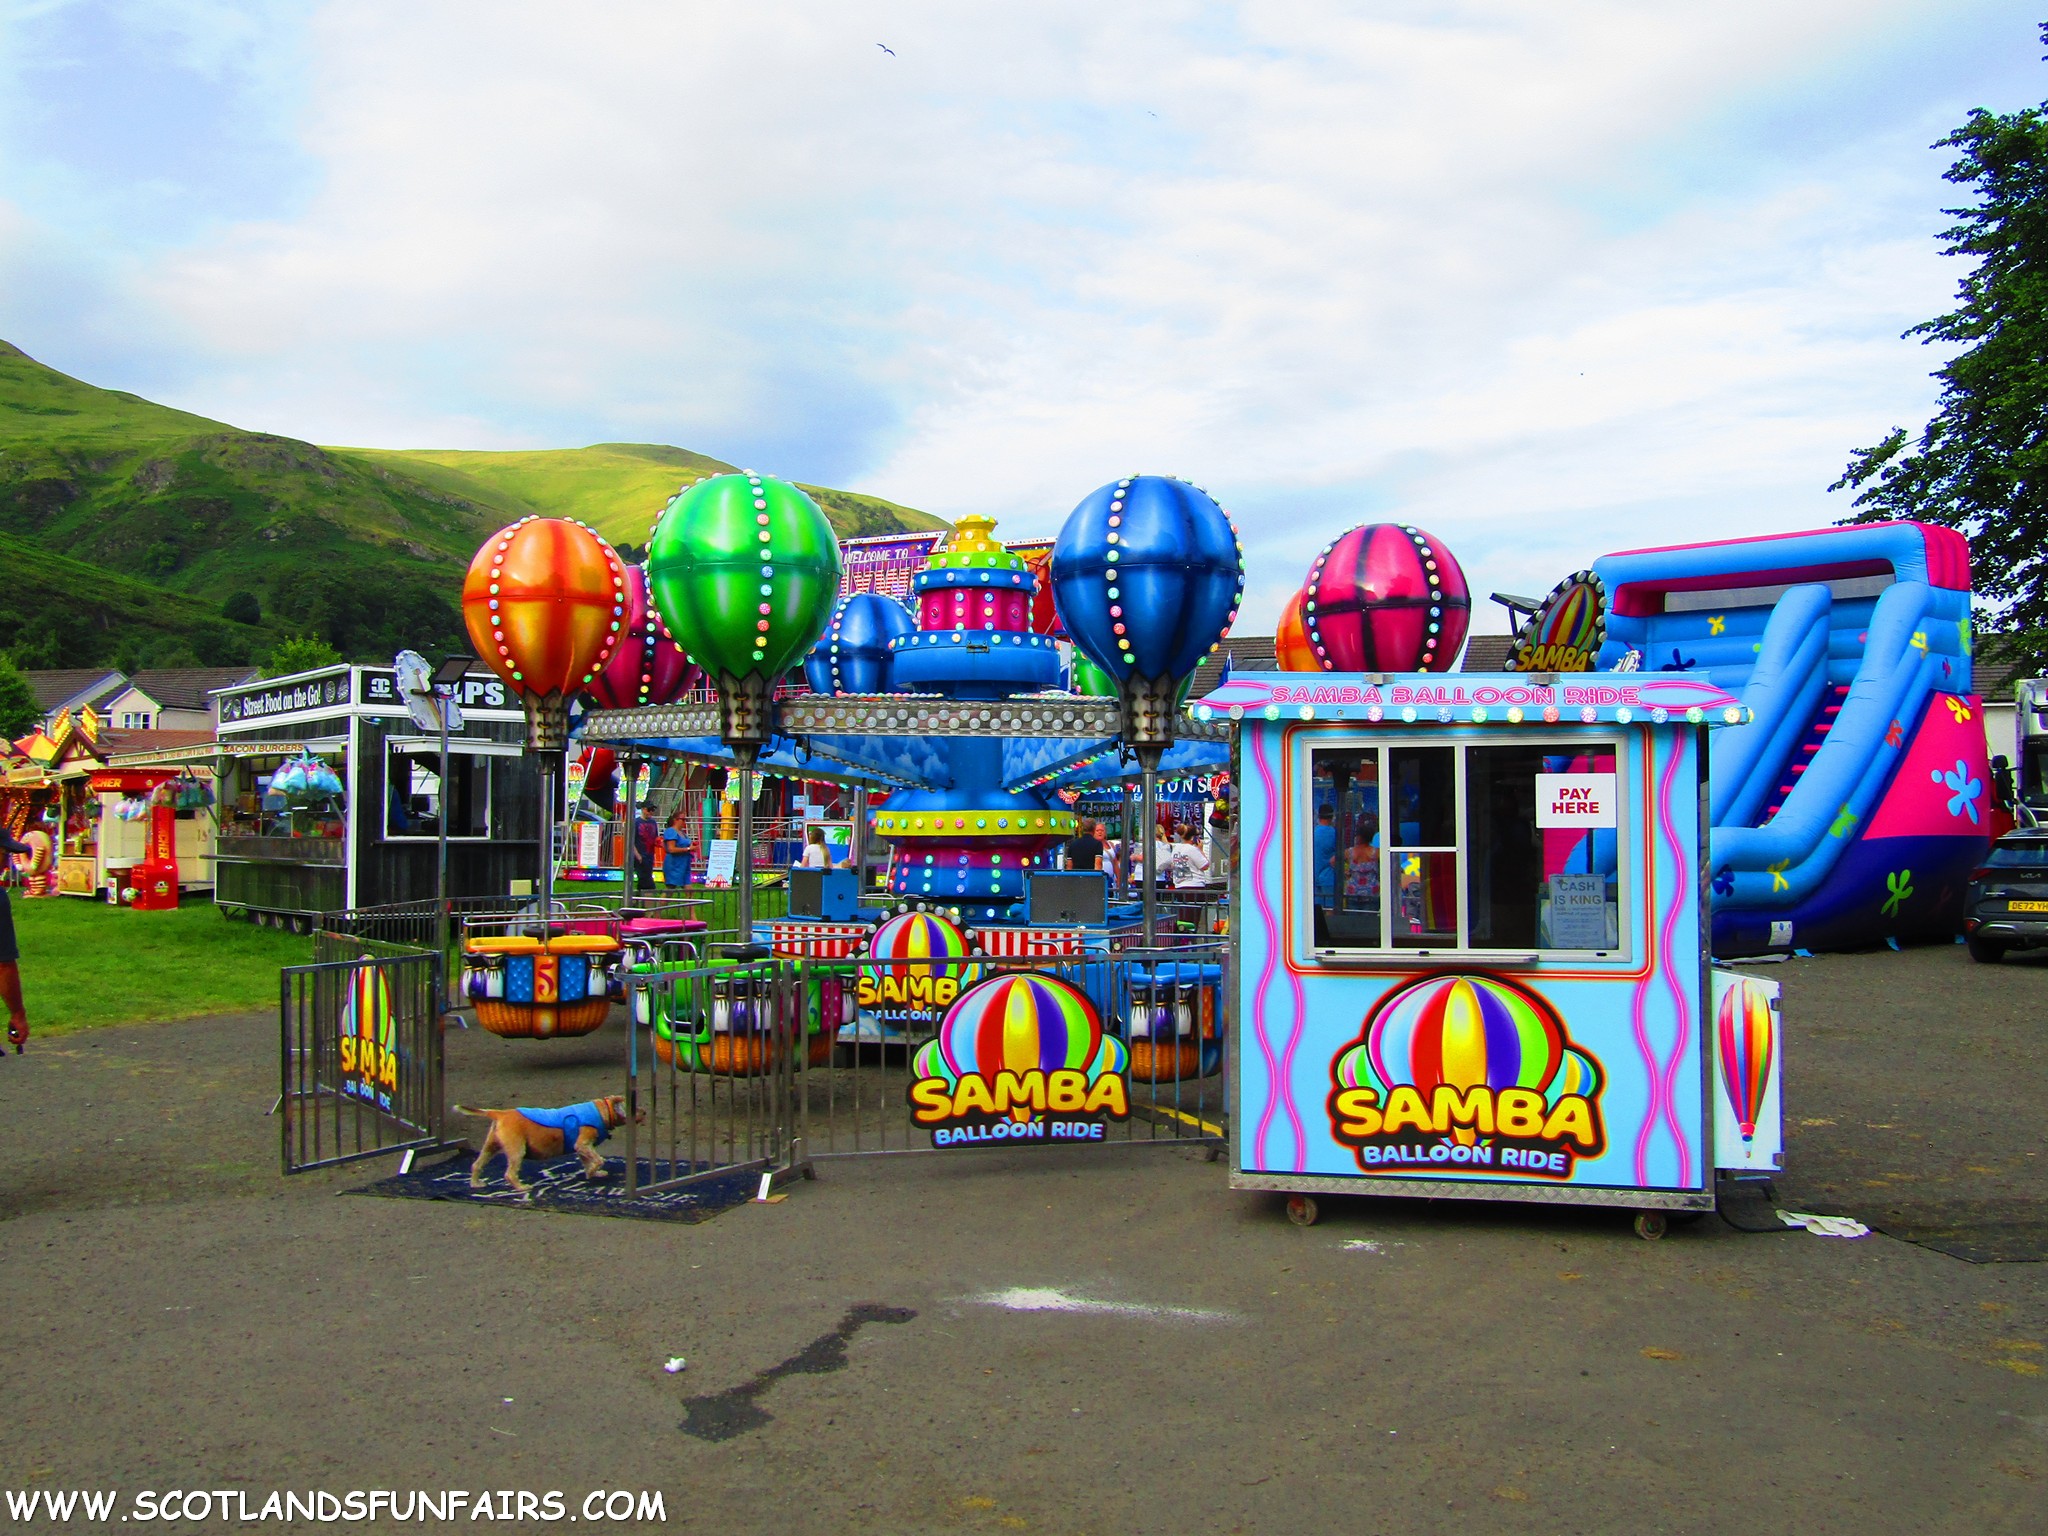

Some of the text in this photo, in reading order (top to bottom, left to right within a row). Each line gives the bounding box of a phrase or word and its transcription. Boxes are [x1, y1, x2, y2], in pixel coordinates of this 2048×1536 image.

[843, 548, 908, 565] WELCOME TO
[1516, 645, 1589, 671] SAMBA
[243, 683, 321, 717] Street Food on the Go!
[1271, 686, 1642, 706] SAMBA BALLOON RIDE
[223, 744, 303, 753] BACON BURGERS
[1559, 788, 1592, 800] PAY
[1552, 802, 1600, 814] HERE
[1559, 882, 1595, 891] CASH
[1554, 895, 1602, 905] IS KING
[2012, 902, 2035, 910] DE72
[538, 965, 554, 996] 5
[857, 976, 957, 1005] SAMB
[911, 1070, 1129, 1122] SAMBA
[1337, 1086, 1595, 1146] SAMBA
[934, 1121, 1104, 1145] BALLOON RIDE
[1364, 1145, 1567, 1171] BALLOON RIDE
